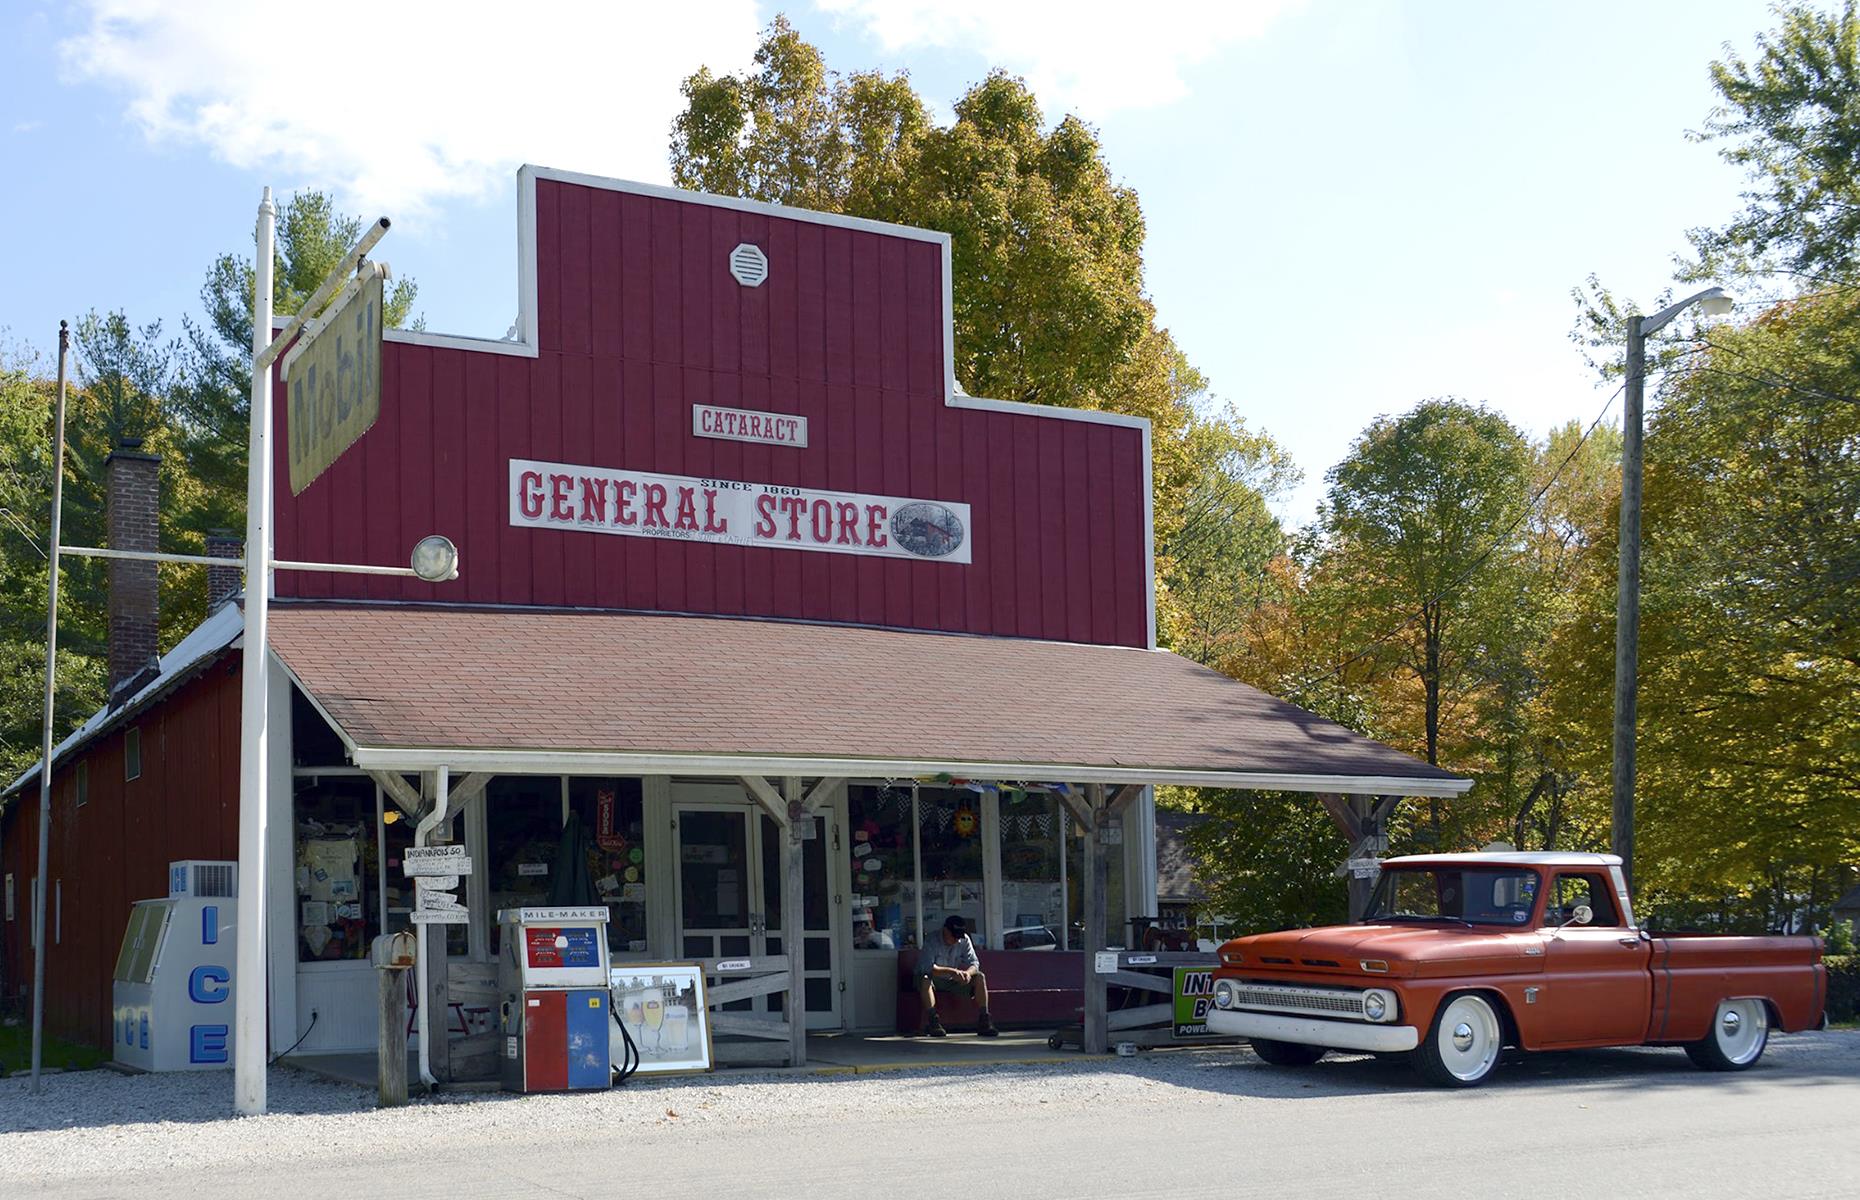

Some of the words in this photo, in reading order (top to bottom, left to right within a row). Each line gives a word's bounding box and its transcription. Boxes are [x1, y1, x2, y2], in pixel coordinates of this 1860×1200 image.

[294, 300, 374, 465] Mobil
[702, 409, 798, 442] CATARACT
[700, 479, 752, 492] SINCE
[762, 485, 801, 497] 1860
[518, 470, 728, 534] GENERAL
[755, 494, 888, 548] STORE
[642, 528, 690, 539] PROPRIETORS
[170, 866, 187, 893] ICE
[524, 910, 606, 919] MILE-MAKER
[188, 906, 230, 1064] ICE
[114, 1007, 149, 1050] ICE
